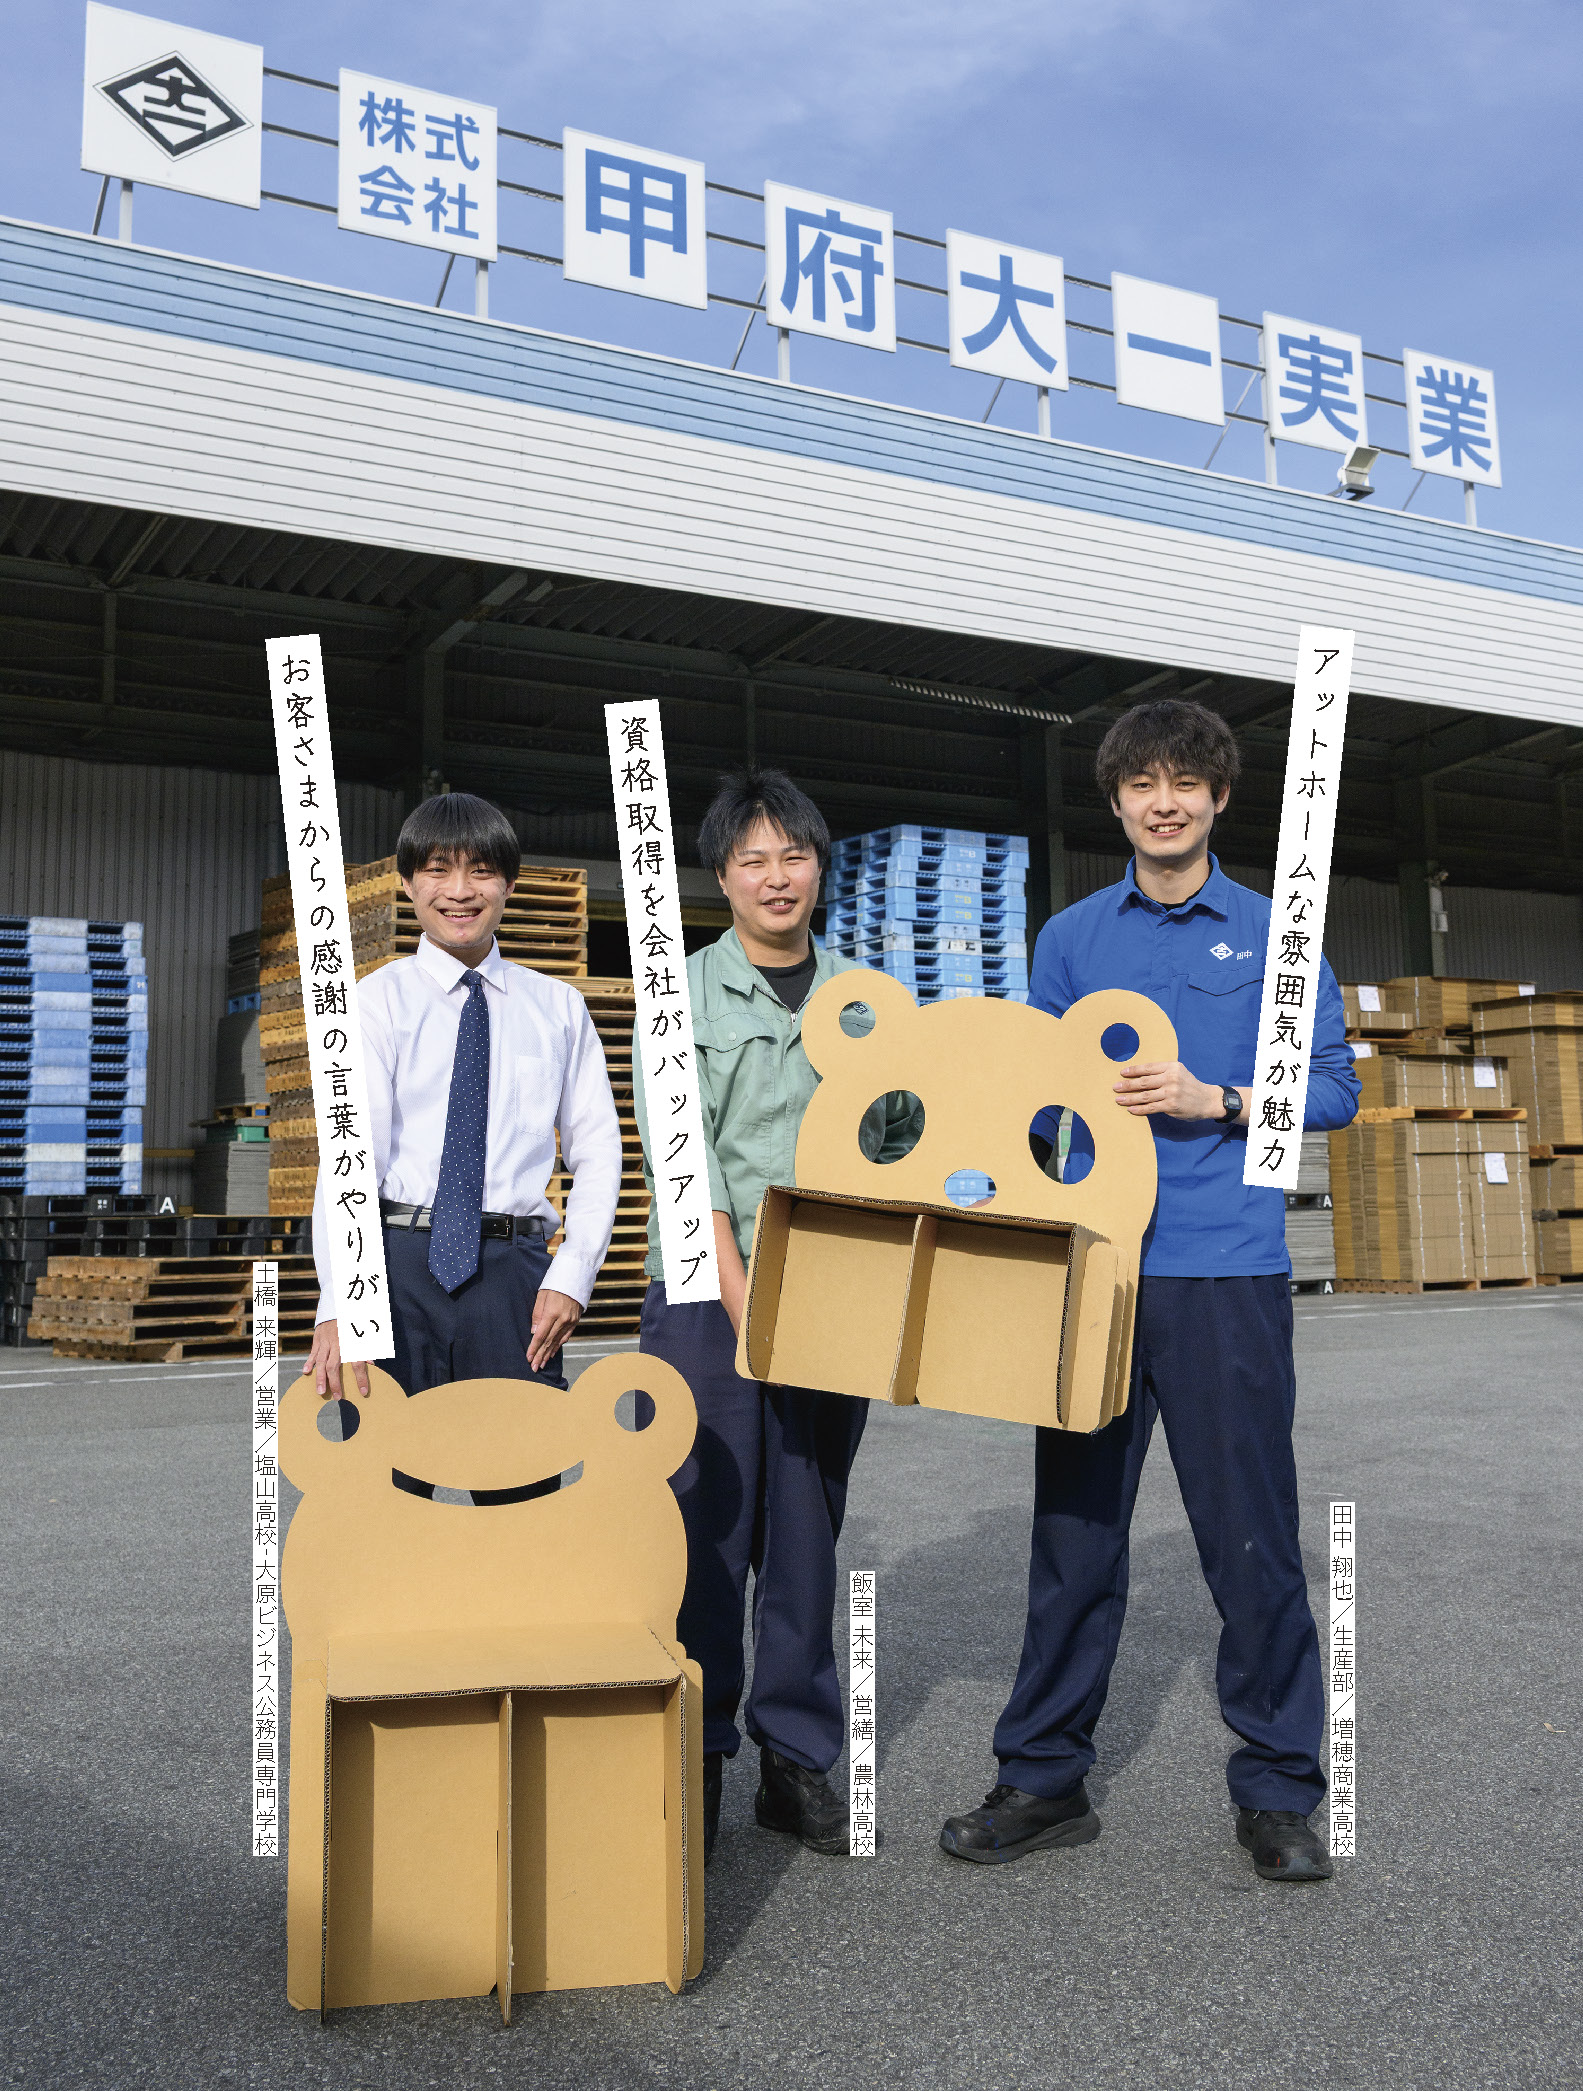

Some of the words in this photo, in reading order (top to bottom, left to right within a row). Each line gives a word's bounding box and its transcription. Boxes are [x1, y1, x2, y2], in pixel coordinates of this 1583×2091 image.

[359, 91, 480, 171] 株式
[358, 165, 479, 239] 会社
[585, 148, 1493, 473] 甲府大一実業
[1236, 950, 1253, 960] 田中
[160, 1196, 175, 1214] A
[1323, 1195, 1332, 1208] A
[1324, 1281, 1334, 1294] A
